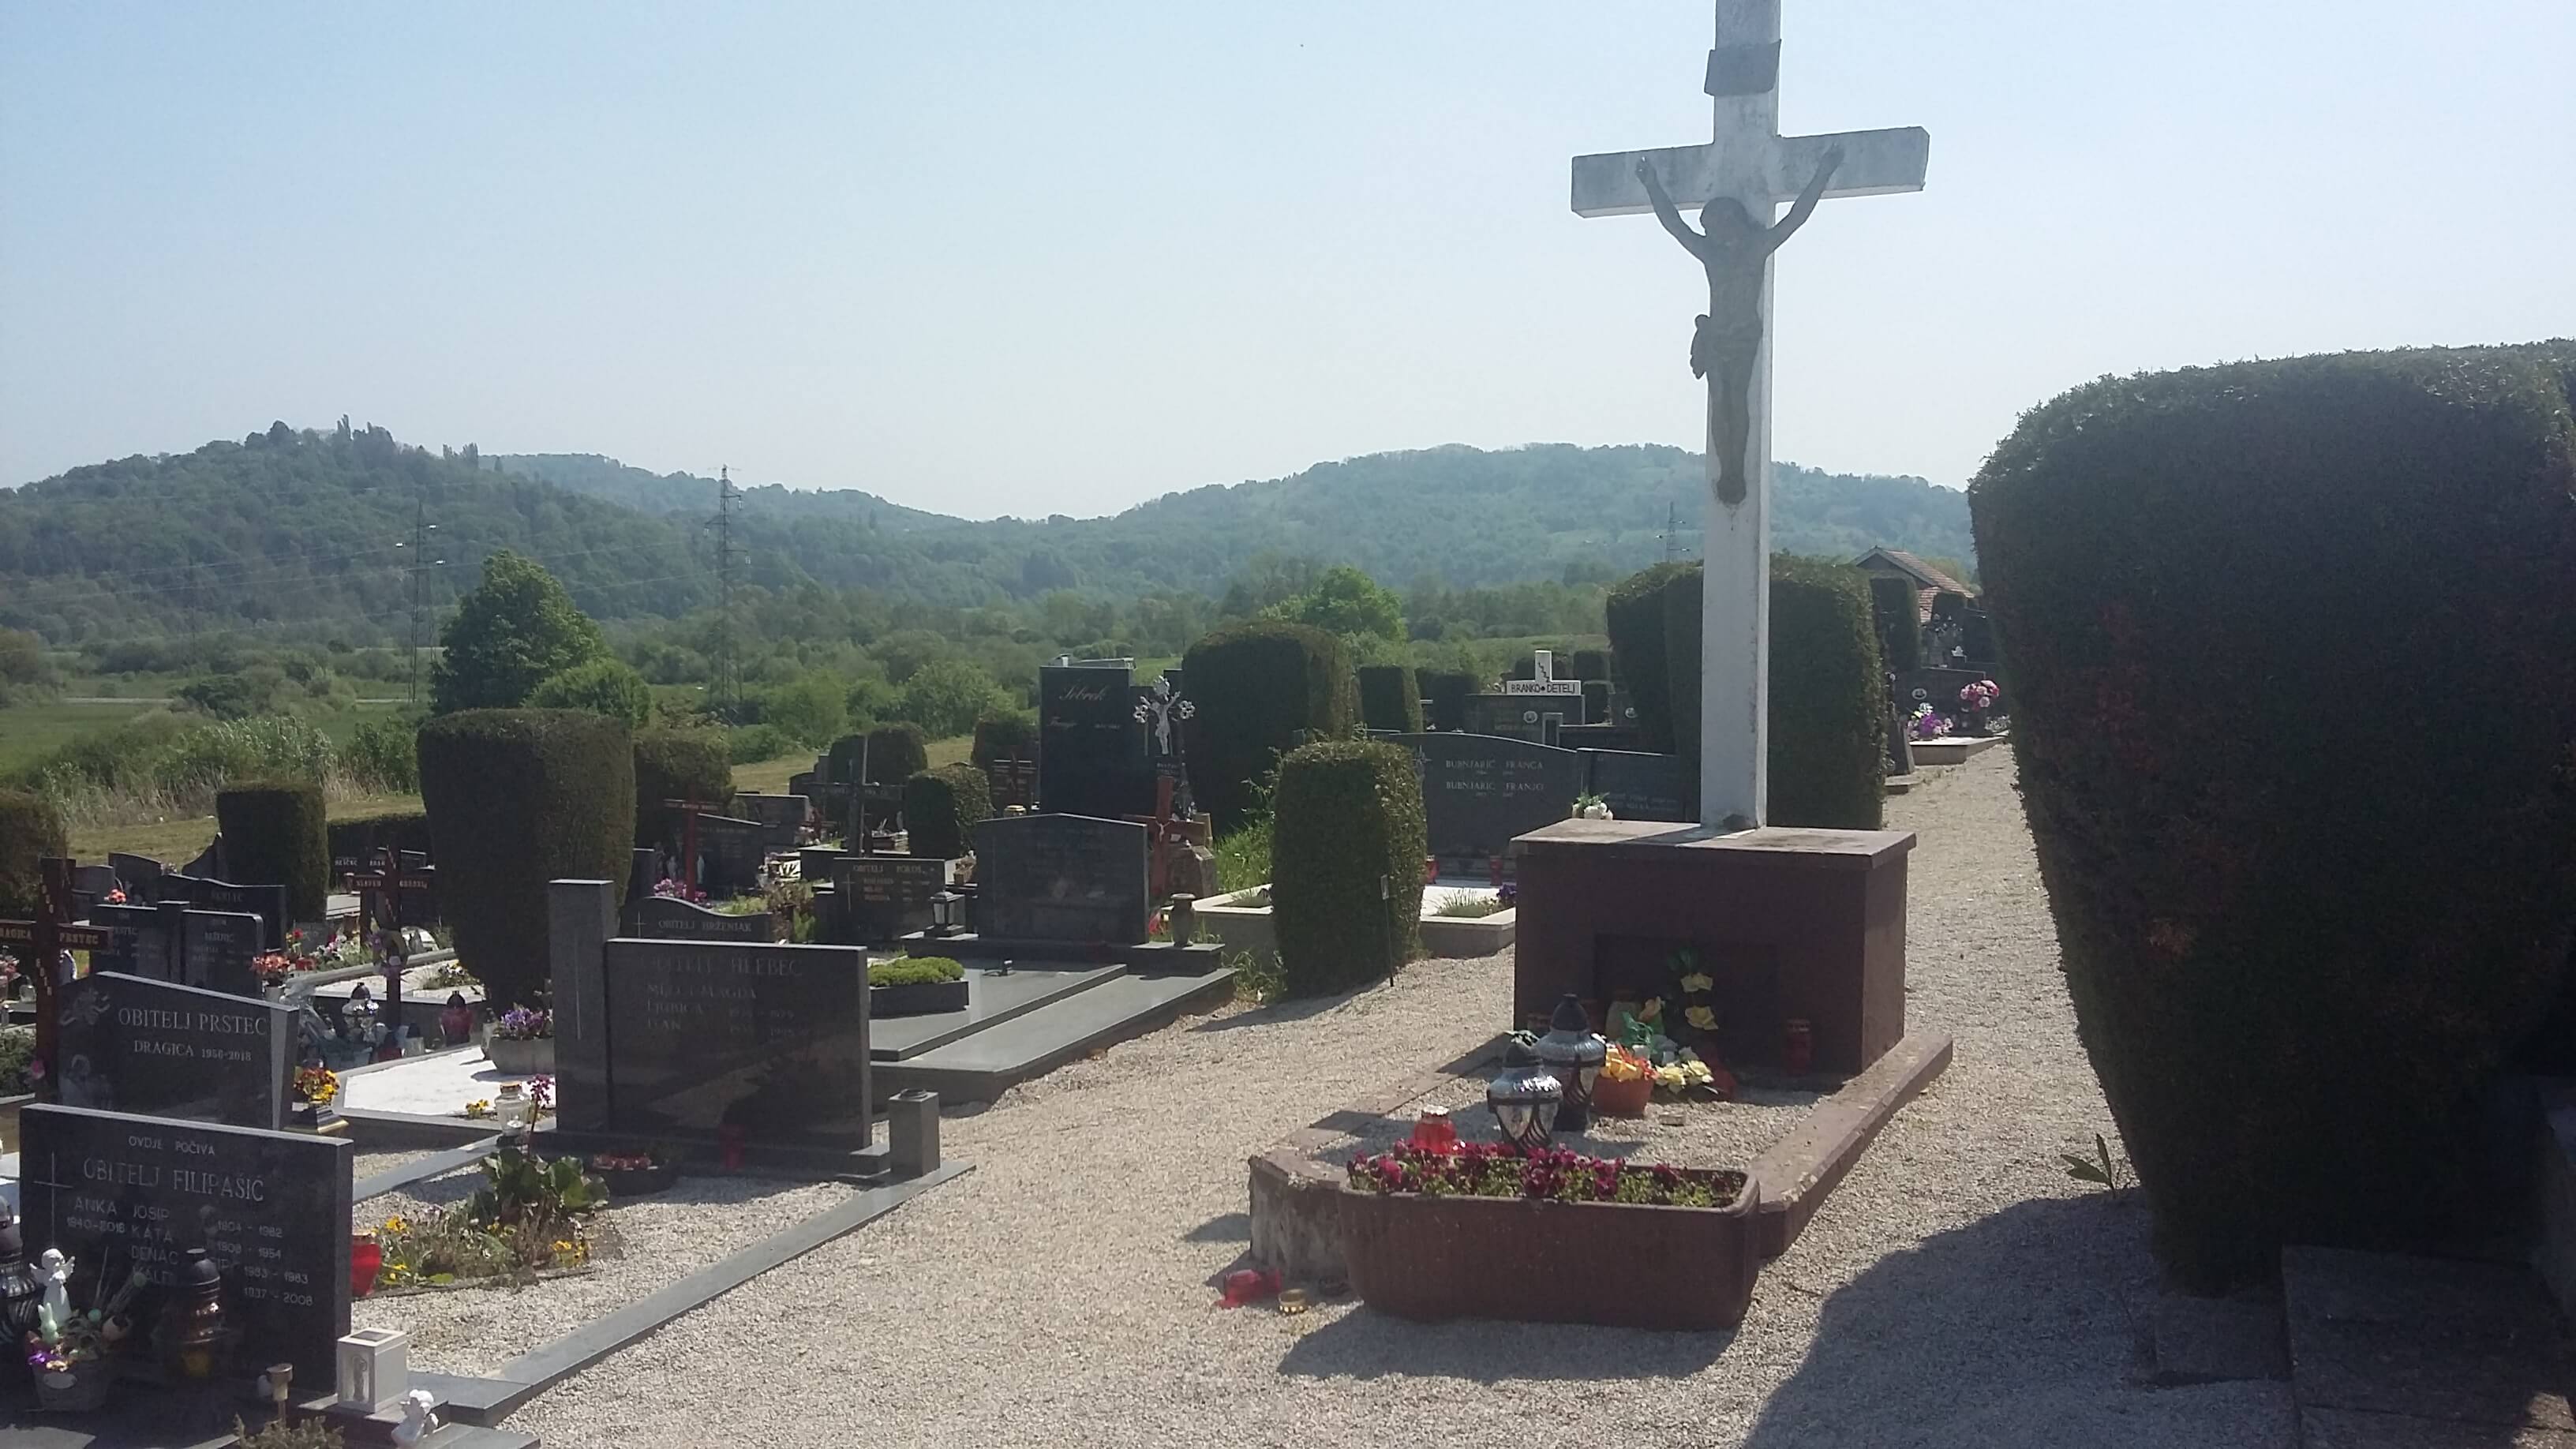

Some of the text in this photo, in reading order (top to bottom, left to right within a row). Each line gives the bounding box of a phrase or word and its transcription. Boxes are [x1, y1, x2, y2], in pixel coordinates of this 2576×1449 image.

[1511, 683, 1576, 694] BRANKO DETELJ
[118, 1007, 268, 1035] OBITELJ PRSTEC
[133, 1039, 195, 1058] DRAGICA
[128, 1135, 215, 1157] OVDJE POČIVA
[83, 1156, 161, 1189] OBITELJ
[74, 1196, 118, 1217] ANKA
[133, 1204, 170, 1222] JOSIP
[258, 1223, 284, 1239] 1982
[131, 1224, 173, 1245] KATA
[257, 1245, 283, 1261] 1954
[130, 1244, 178, 1265] DENAC
